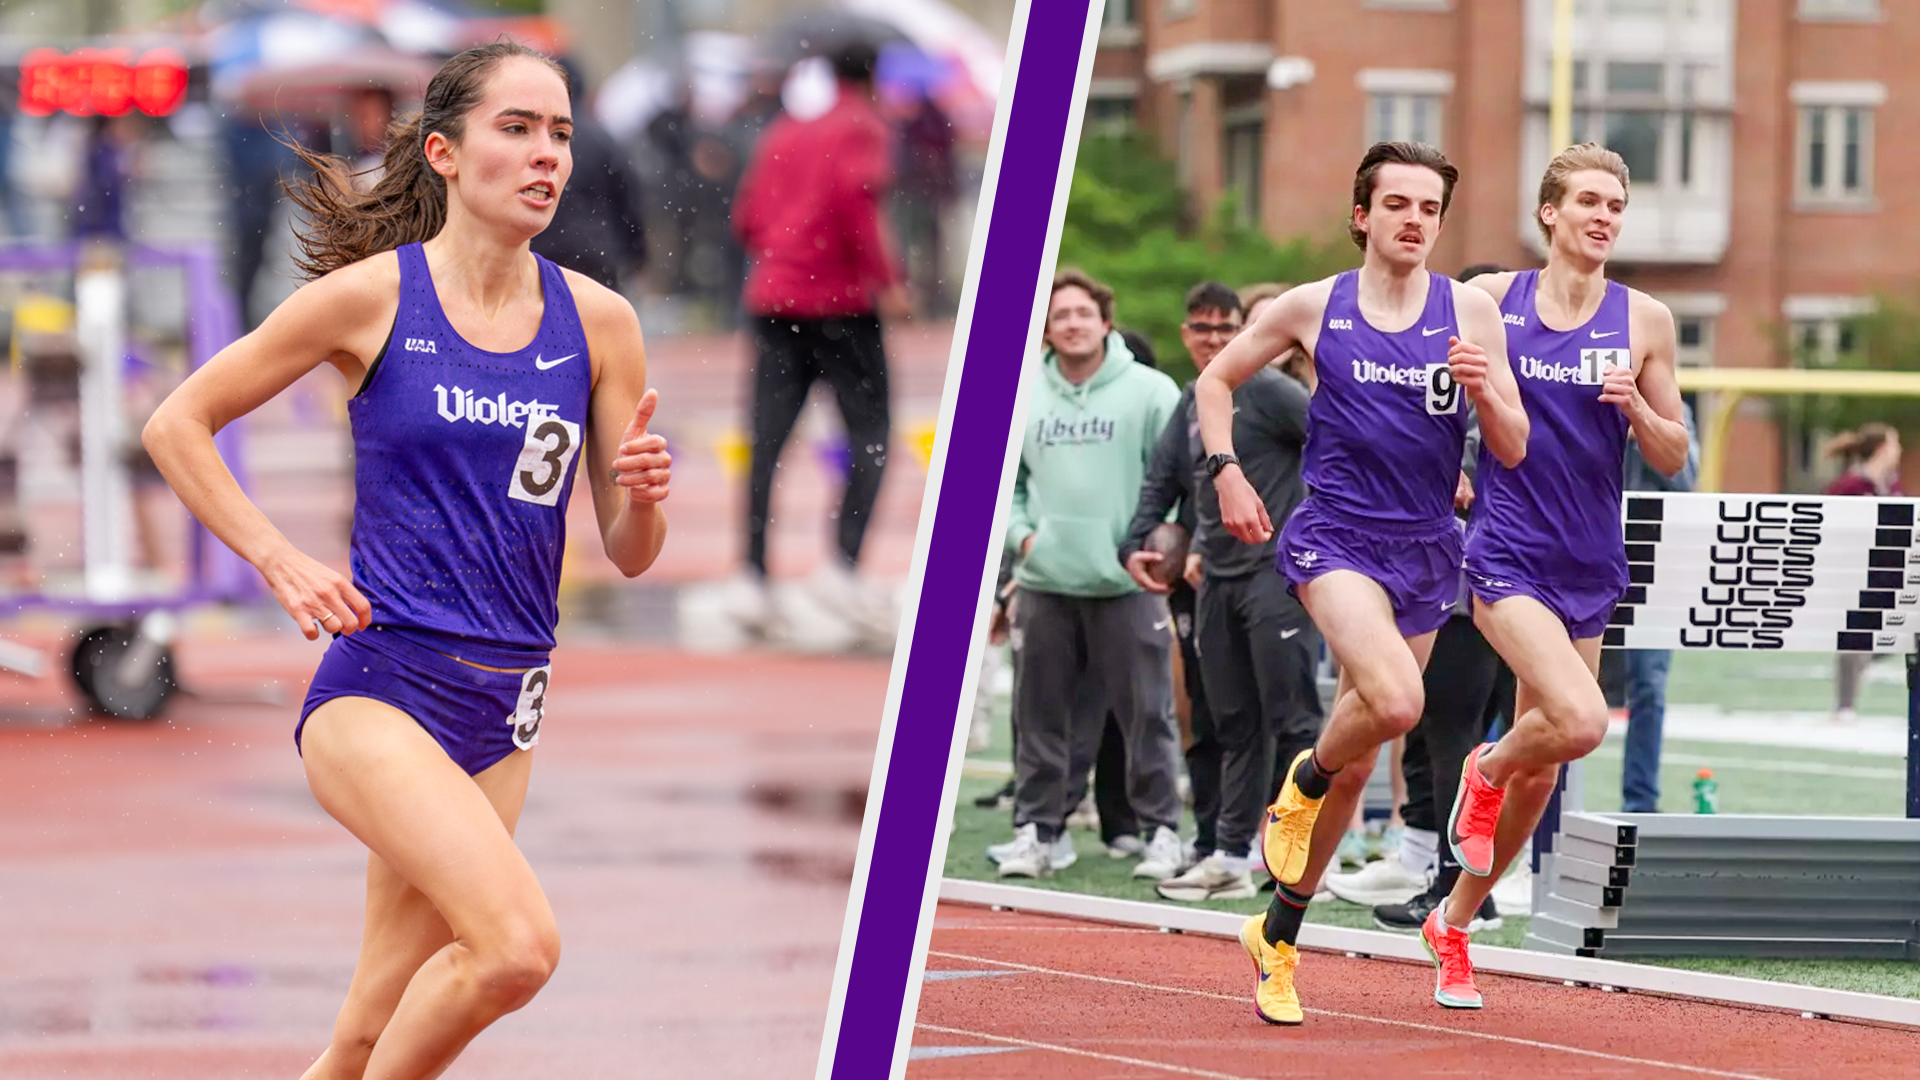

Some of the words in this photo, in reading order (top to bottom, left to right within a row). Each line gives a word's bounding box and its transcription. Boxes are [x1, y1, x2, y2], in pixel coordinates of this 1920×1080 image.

[1328, 318, 1353, 331] UAA
[404, 337, 438, 355] UAA
[1351, 359, 1427, 387] Violets
[1431, 366, 1457, 412] 9
[519, 420, 571, 497] 3
[1719, 500, 1824, 525] UCS
[1716, 524, 1822, 546] UCS
[1710, 545, 1815, 567] UCS
[1709, 565, 1814, 587] UCS
[1701, 586, 1806, 607] UCS
[1689, 607, 1794, 629] UCS
[1680, 628, 1784, 649] UCS
[517, 669, 549, 744] 3
